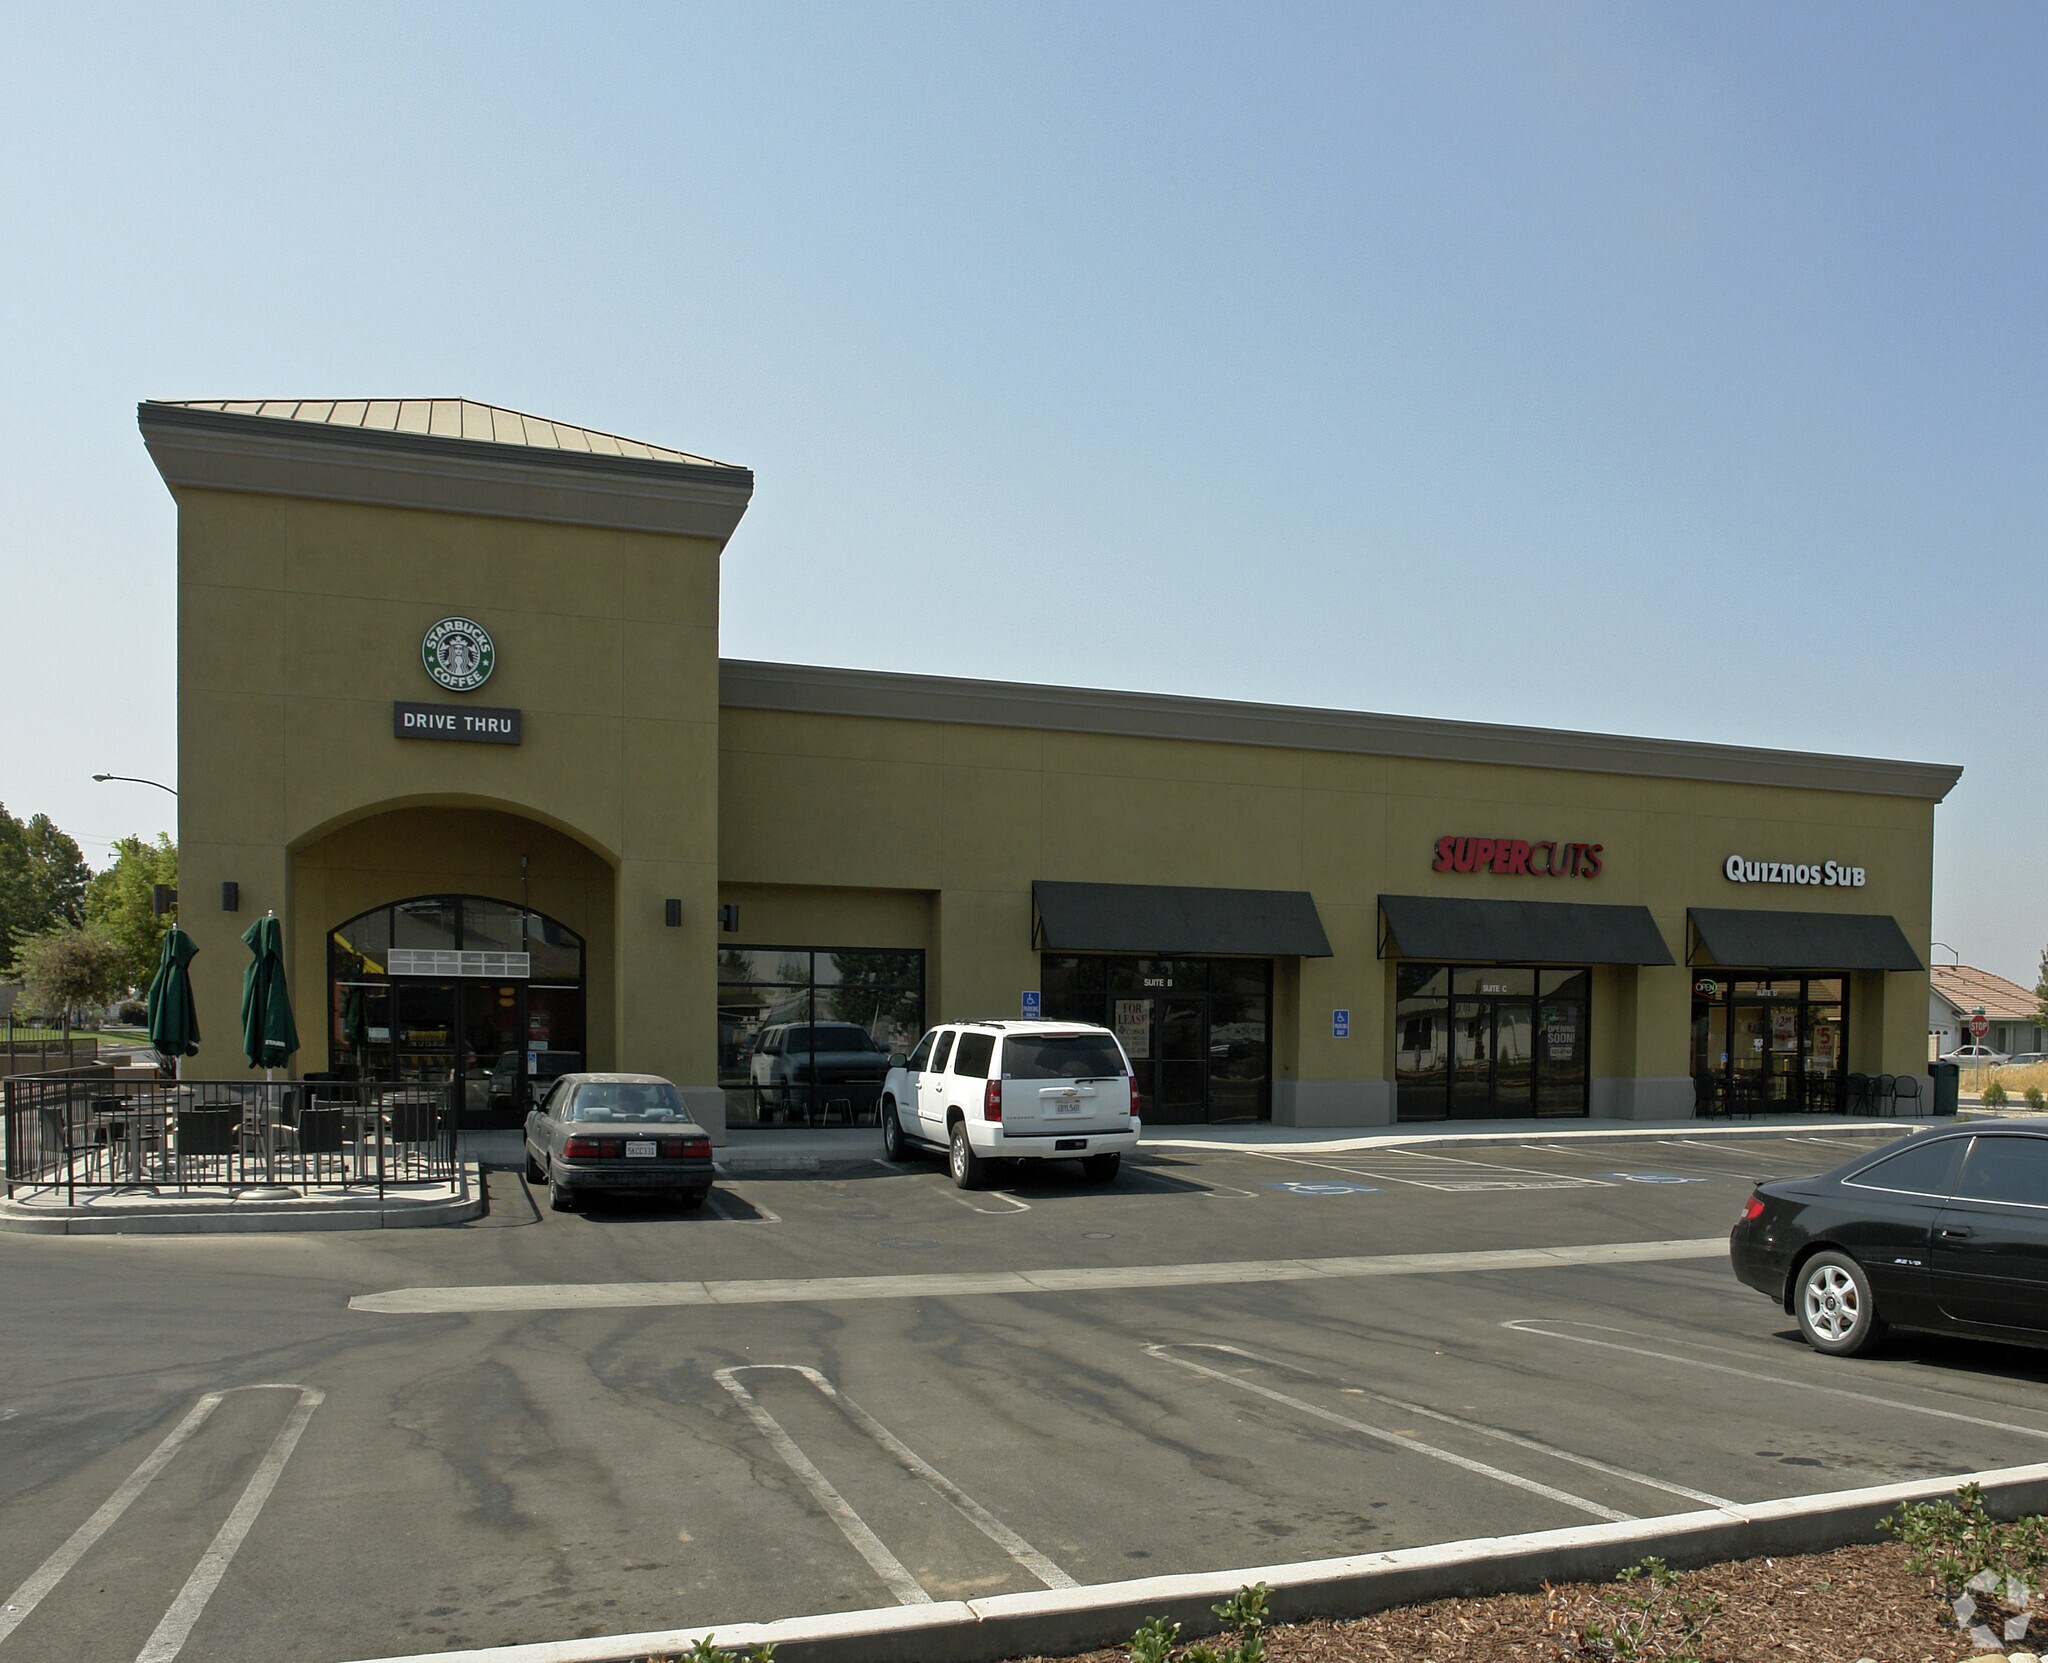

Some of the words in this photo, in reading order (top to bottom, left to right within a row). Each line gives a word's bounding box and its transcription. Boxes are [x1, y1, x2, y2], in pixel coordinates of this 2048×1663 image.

[426, 620, 491, 653] STARBUCKS
[433, 667, 483, 687] COFFEE
[404, 712, 457, 730] DRIVE
[464, 716, 511, 733] THRU
[1432, 835, 1604, 878] SUPERCUTS
[1144, 978, 1164, 987] SUITE
[1167, 979, 1173, 987] B
[1695, 983, 1715, 991] OPEN
[1482, 984, 1500, 992] SUITE
[1123, 1003, 1142, 1013] FOR
[1118, 1014, 1146, 1025] LEASE
[1547, 1025, 1576, 1033] OPENING
[1971, 1021, 1988, 1031] STOP
[1547, 1033, 1576, 1044] SOON!
